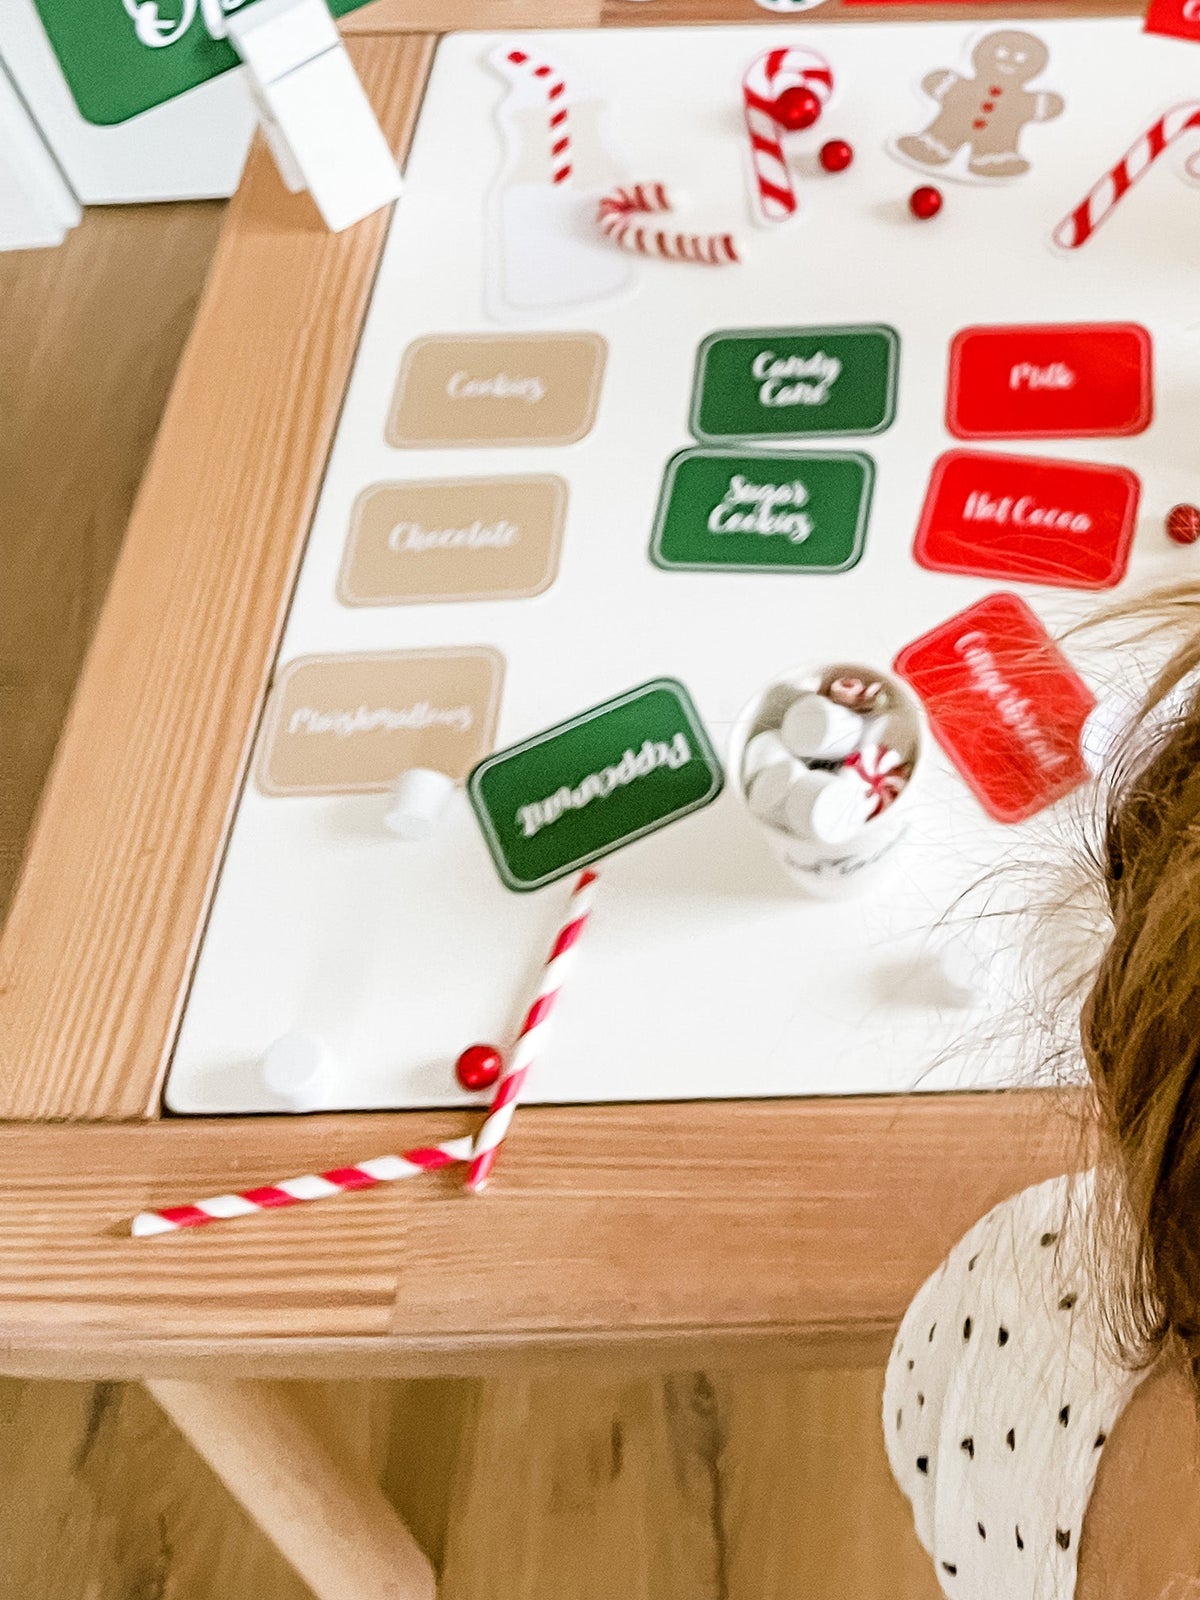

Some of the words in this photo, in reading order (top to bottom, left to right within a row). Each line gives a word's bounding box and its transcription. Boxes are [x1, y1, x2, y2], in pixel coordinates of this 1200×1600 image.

[752, 350, 843, 388] Candy
[962, 489, 1012, 525] Hot
[1011, 494, 1093, 534] Cocoa
[387, 519, 520, 552] Chocolate
[514, 731, 693, 838] Peppermint
